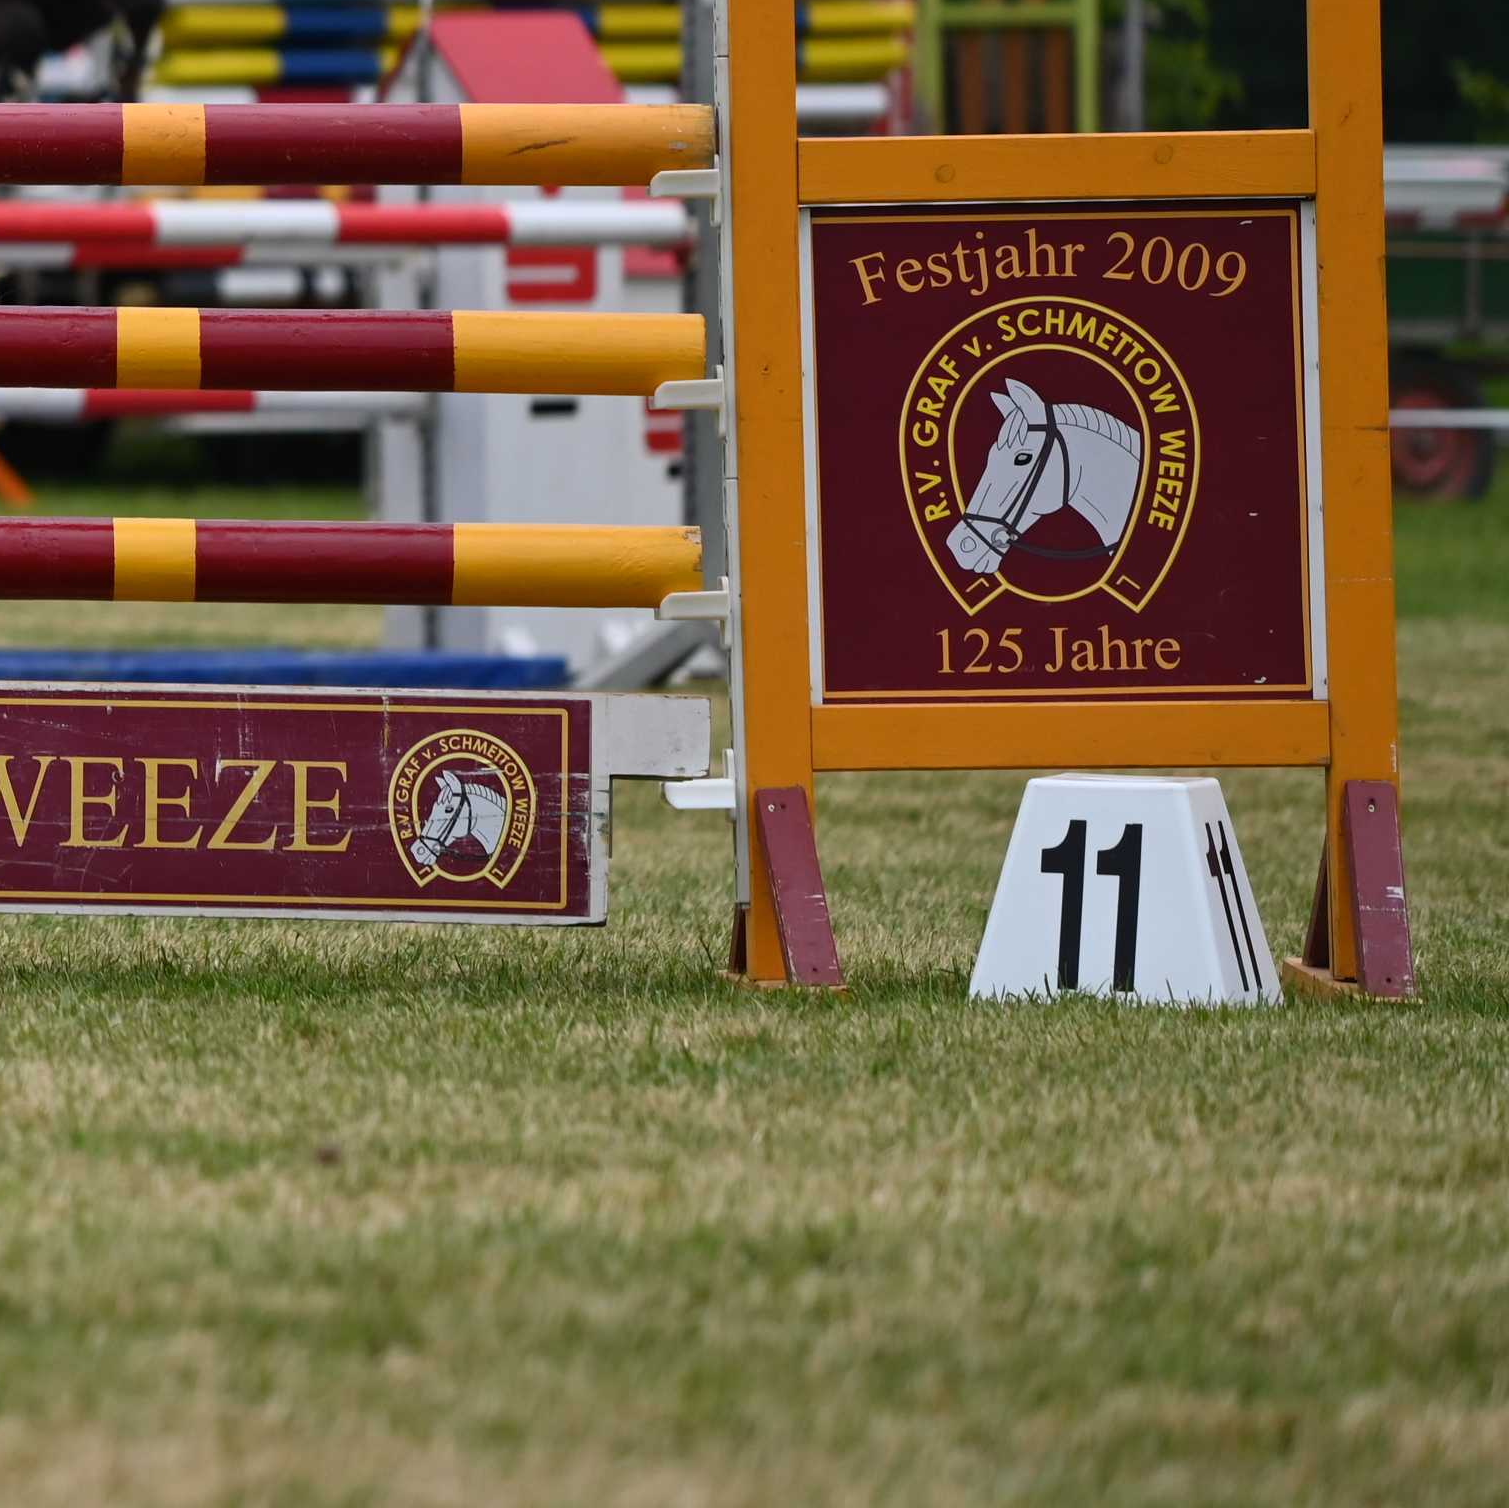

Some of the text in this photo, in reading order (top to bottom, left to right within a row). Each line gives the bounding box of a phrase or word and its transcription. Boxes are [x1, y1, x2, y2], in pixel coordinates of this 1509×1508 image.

[848, 227, 1246, 305] Festjahr 2009
[913, 354, 962, 446] GRAF
[962, 339, 993, 358] v.
[997, 307, 1180, 414] SCHMETTOW
[1147, 428, 1186, 532] WEEZE
[935, 624, 1181, 674] 125 Jahre
[396, 759, 421, 803] GRAF
[422, 748, 437, 760] v.
[439, 736, 526, 790] SCHMETTOW
[508, 798, 529, 849] WEEZE
[1041, 820, 1143, 992] 11
[1206, 820, 1263, 992] 11
